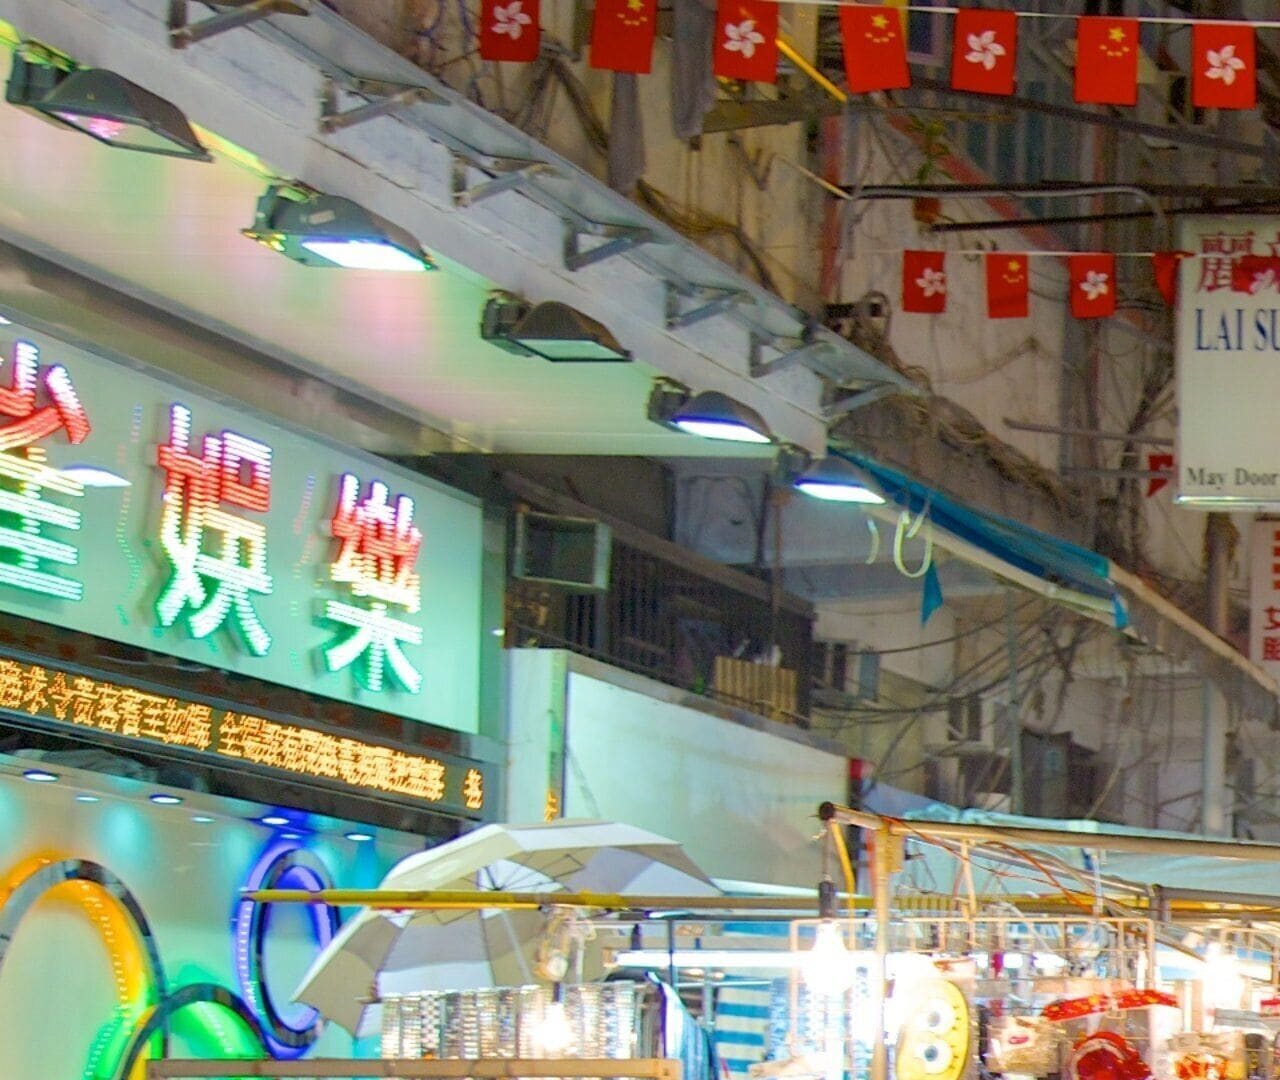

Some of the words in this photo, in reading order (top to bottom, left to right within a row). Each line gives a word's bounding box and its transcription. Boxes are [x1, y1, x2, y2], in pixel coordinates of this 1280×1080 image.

[1195, 309, 1246, 352] LAI
[1188, 467, 1228, 491] May
[1235, 467, 1279, 487] Door
